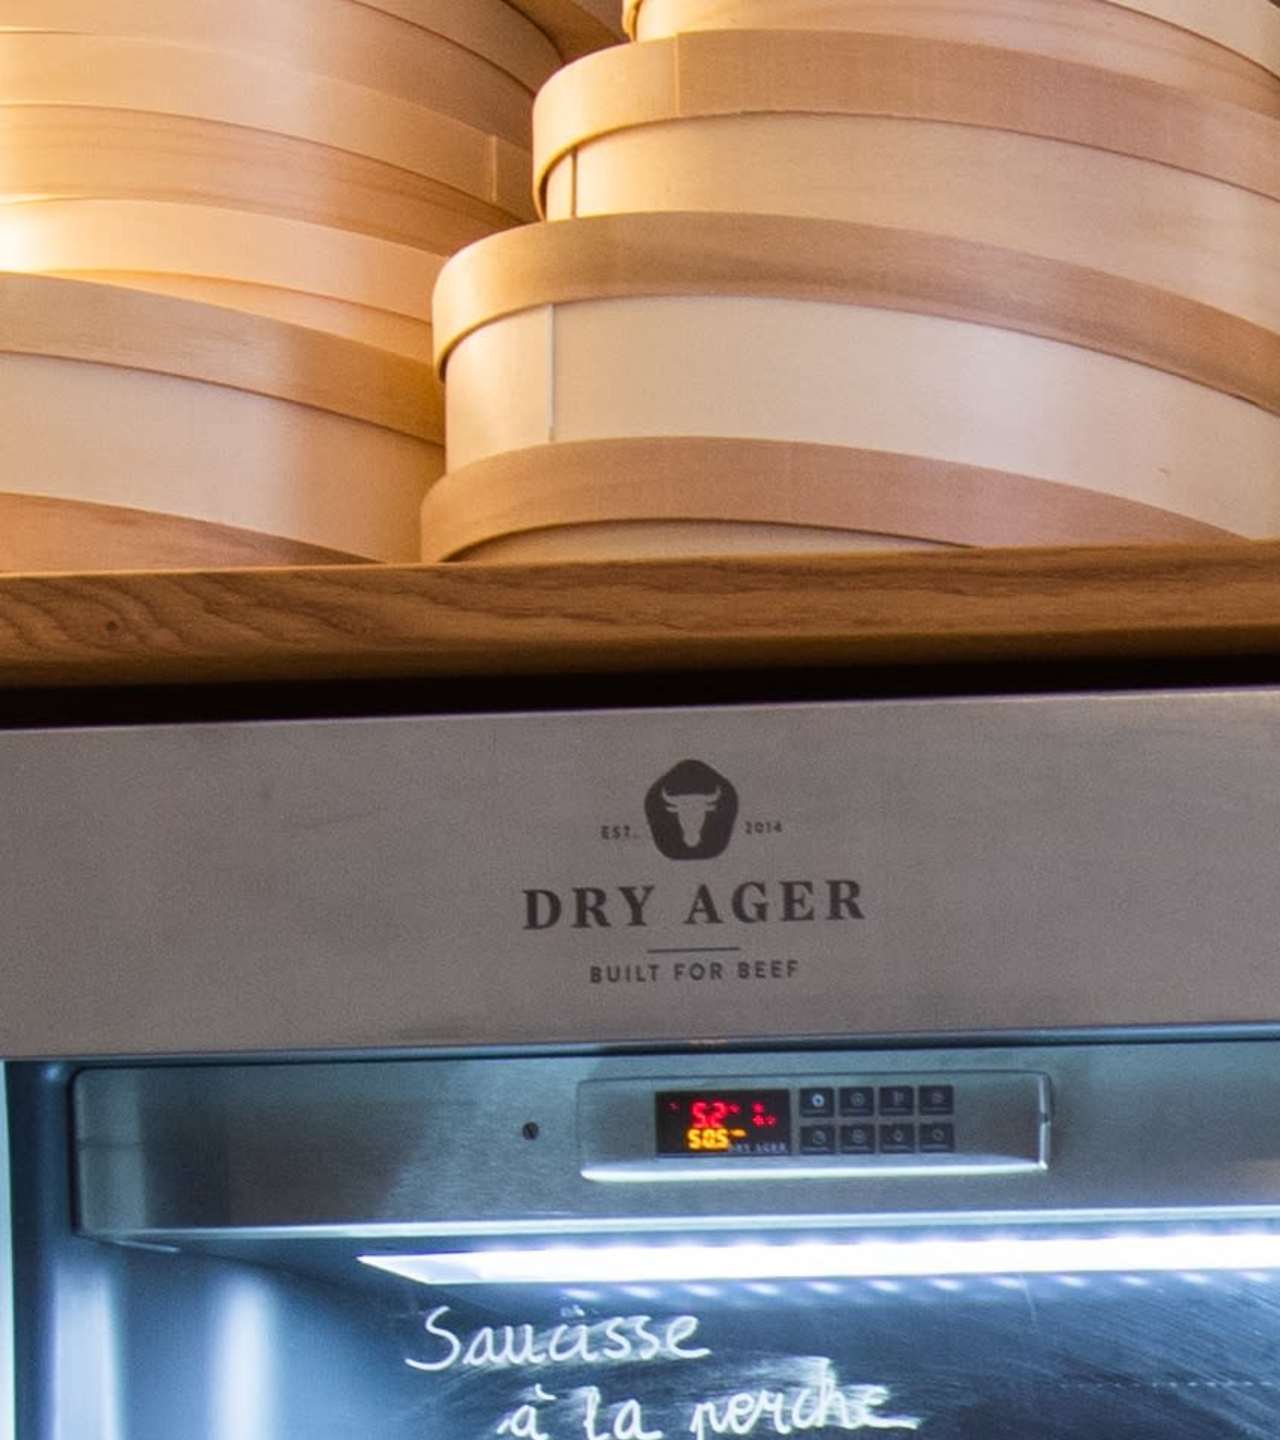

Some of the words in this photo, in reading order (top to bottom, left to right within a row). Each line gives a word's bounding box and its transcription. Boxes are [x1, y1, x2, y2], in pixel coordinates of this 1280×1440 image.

[746, 821, 783, 834] 2014
[522, 886, 655, 930] DRY
[684, 878, 865, 924] AGER
[590, 965, 660, 983] BUILT
[674, 963, 723, 981] FOR
[738, 959, 799, 979] BEEF
[405, 1304, 712, 1372] Saucisse
